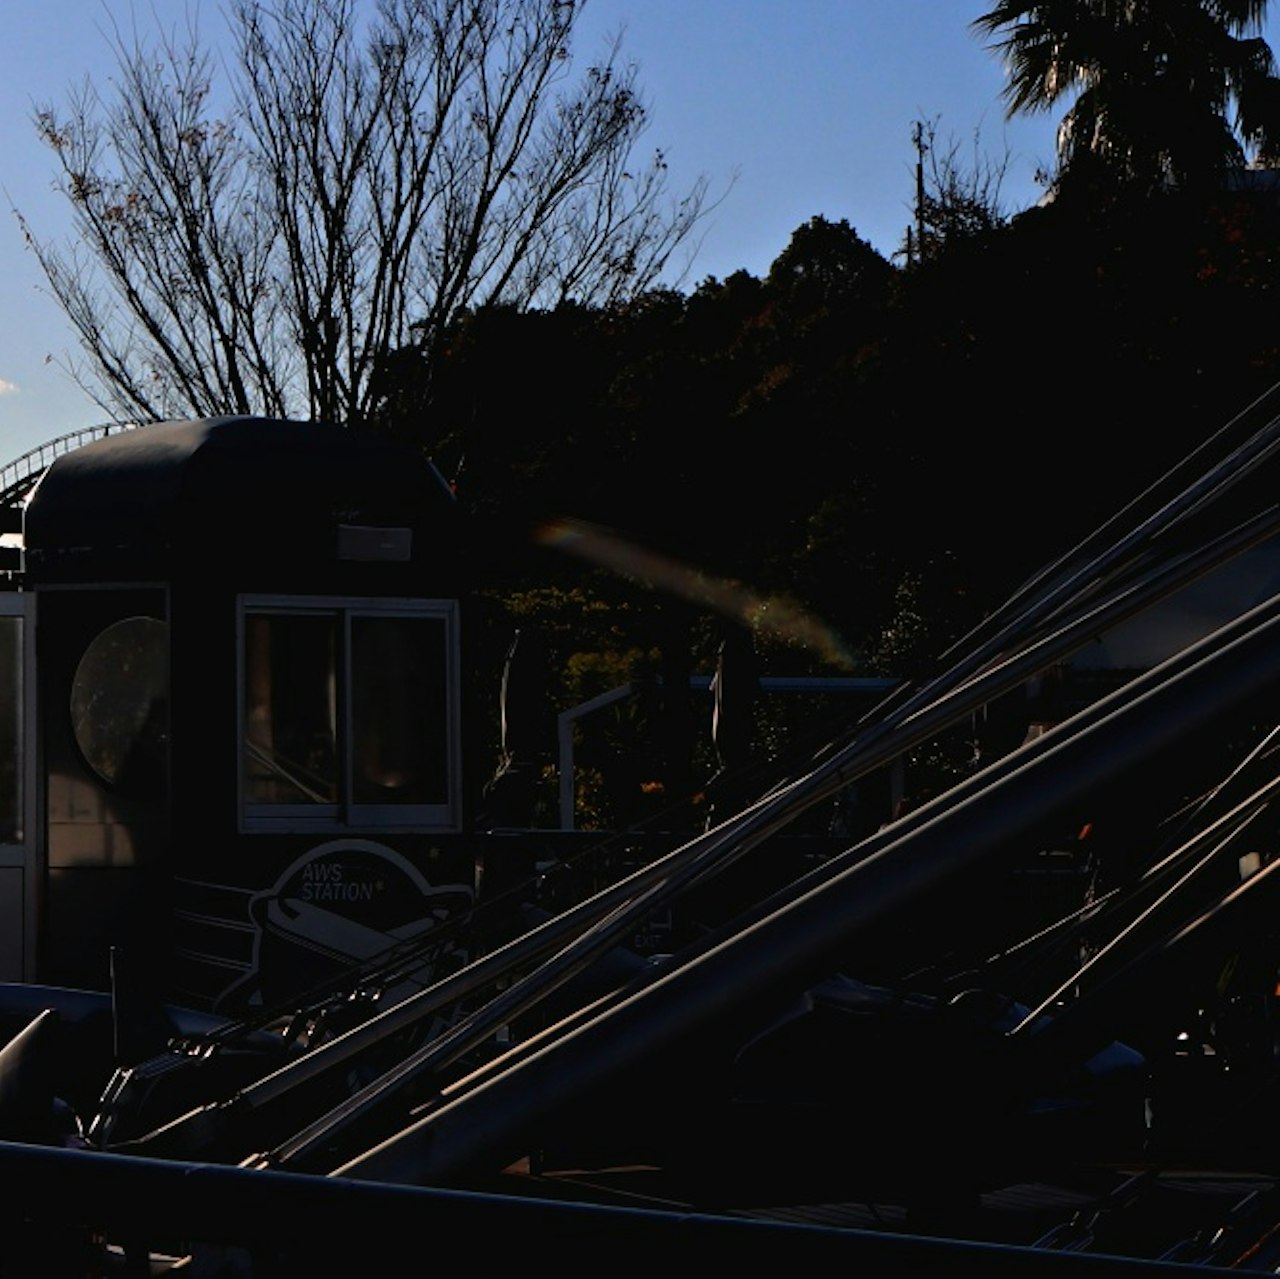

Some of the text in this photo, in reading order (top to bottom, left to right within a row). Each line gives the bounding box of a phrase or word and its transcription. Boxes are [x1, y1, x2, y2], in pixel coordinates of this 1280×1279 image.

[303, 863, 342, 881] AWS
[303, 882, 373, 901] STATION
[634, 934, 662, 948] EXIT
